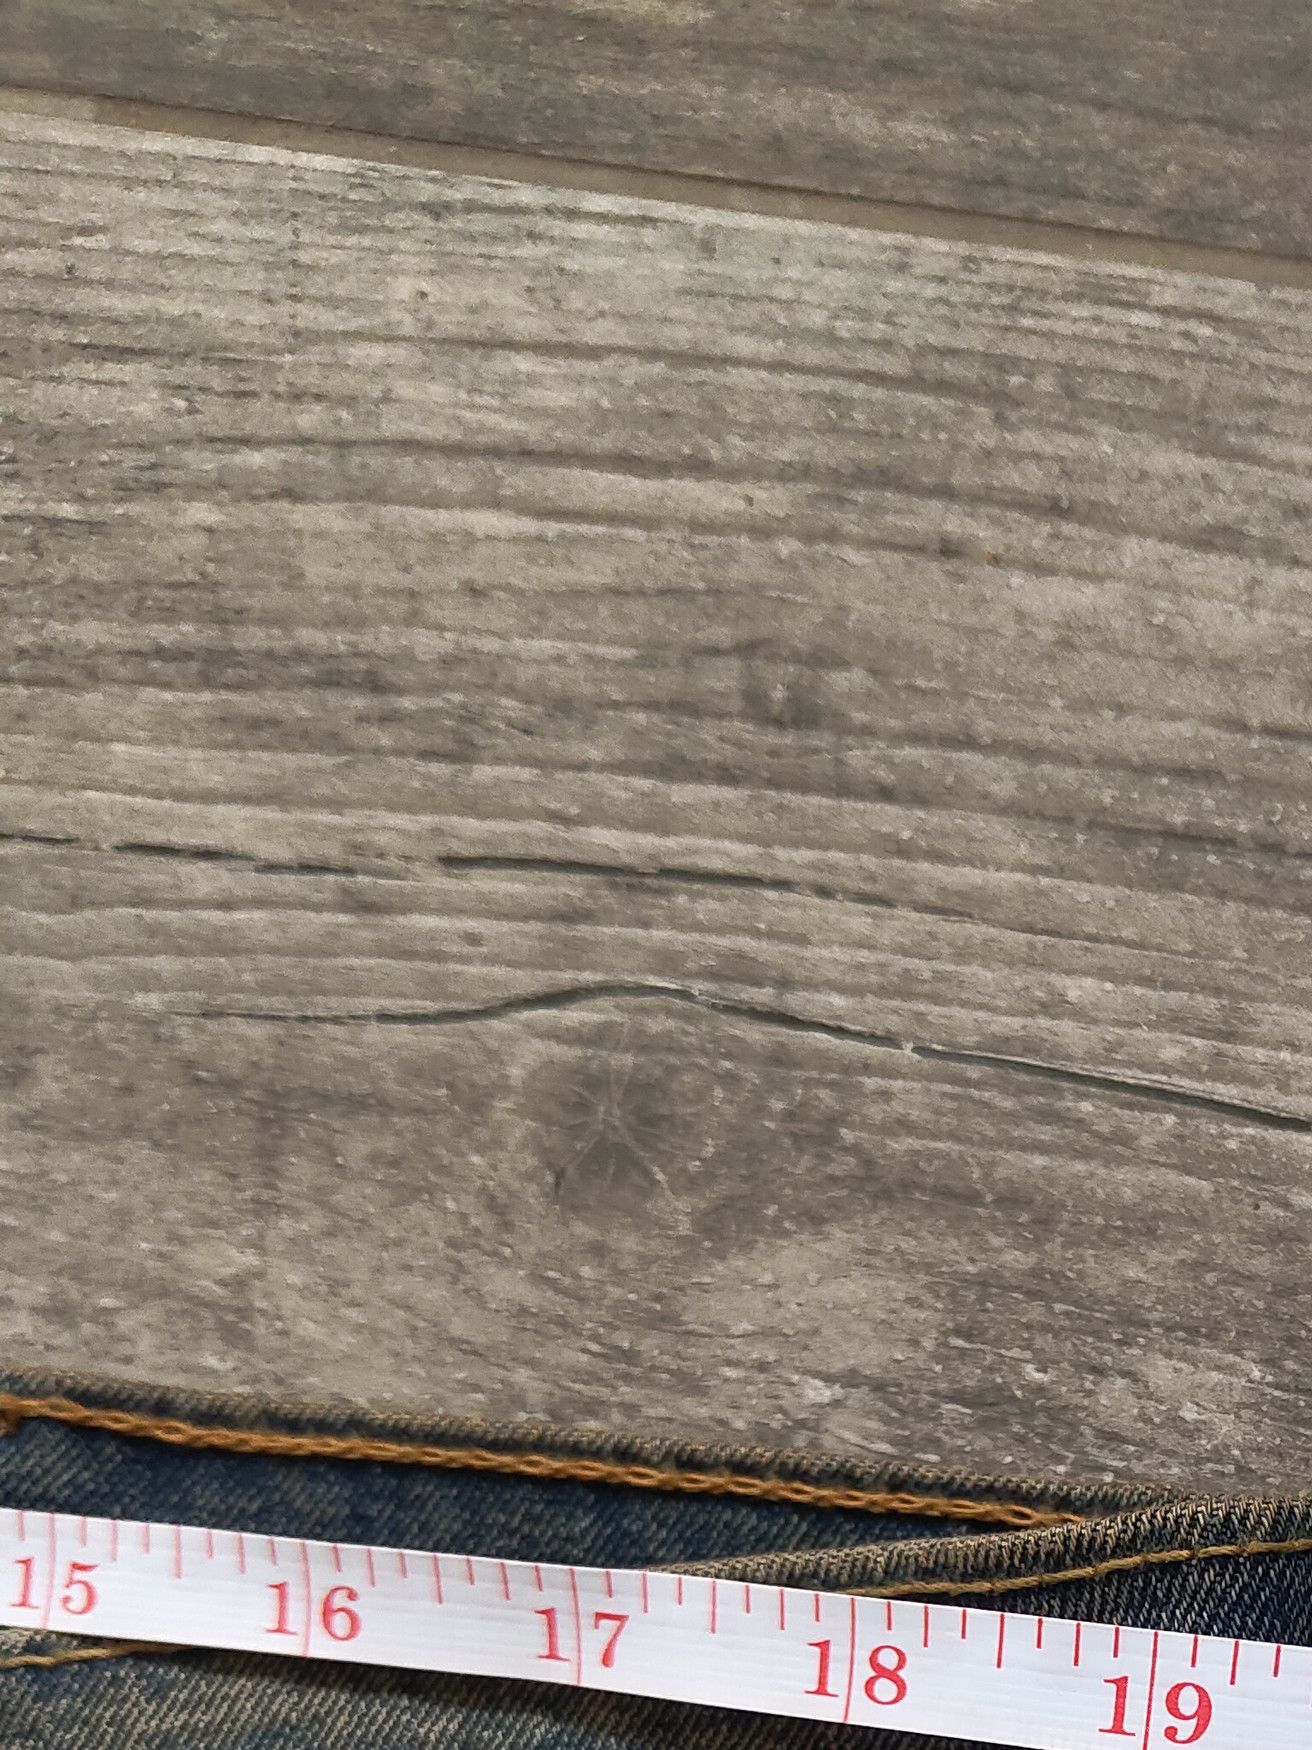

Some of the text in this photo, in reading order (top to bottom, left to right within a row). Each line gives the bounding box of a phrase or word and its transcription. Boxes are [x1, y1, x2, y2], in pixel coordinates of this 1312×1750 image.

[11, 1556, 98, 1616] 15
[265, 1580, 362, 1643] 16
[531, 1607, 630, 1670] 17
[803, 1637, 909, 1707] 18
[1097, 1673, 1214, 1746] 19
